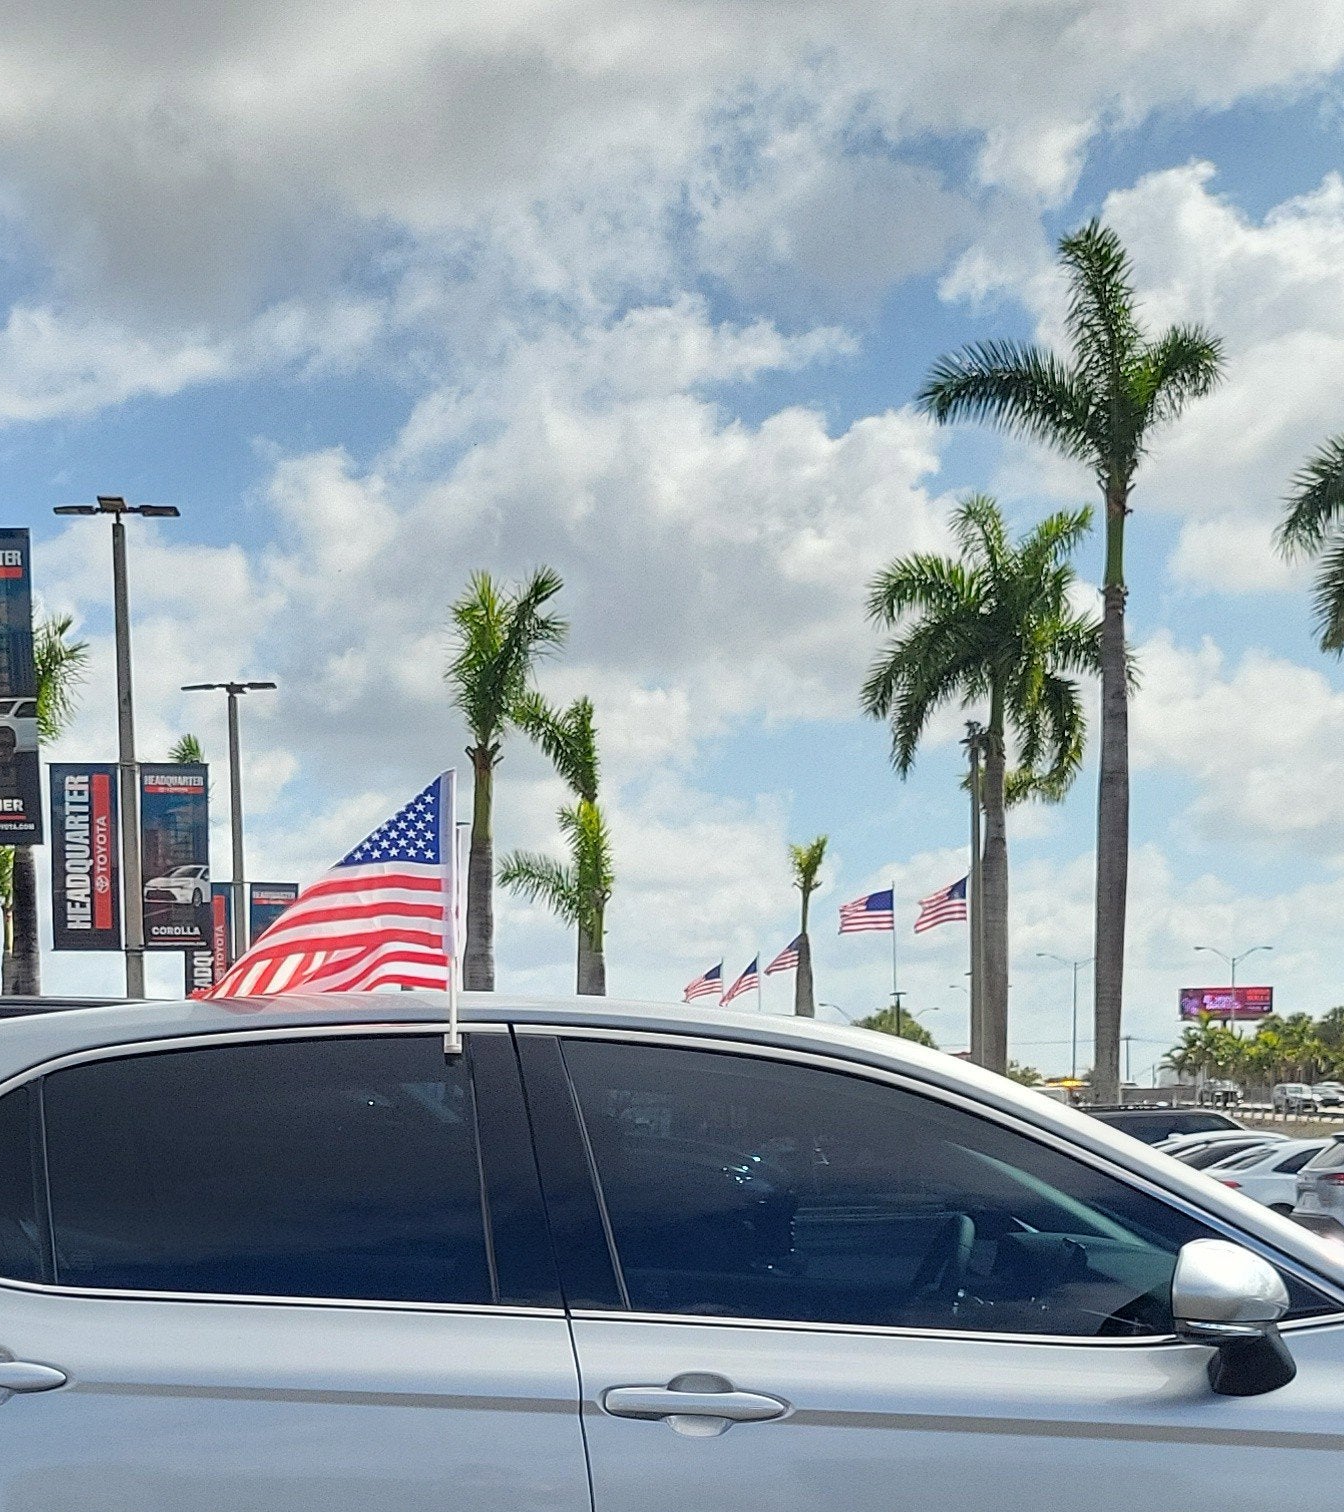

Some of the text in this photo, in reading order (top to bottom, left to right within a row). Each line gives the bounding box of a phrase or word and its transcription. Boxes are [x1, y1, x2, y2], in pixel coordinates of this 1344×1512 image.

[64, 775, 93, 929] HEADQUARTER
[96, 816, 109, 874] TOYOTA
[151, 926, 201, 935] COROLLA
